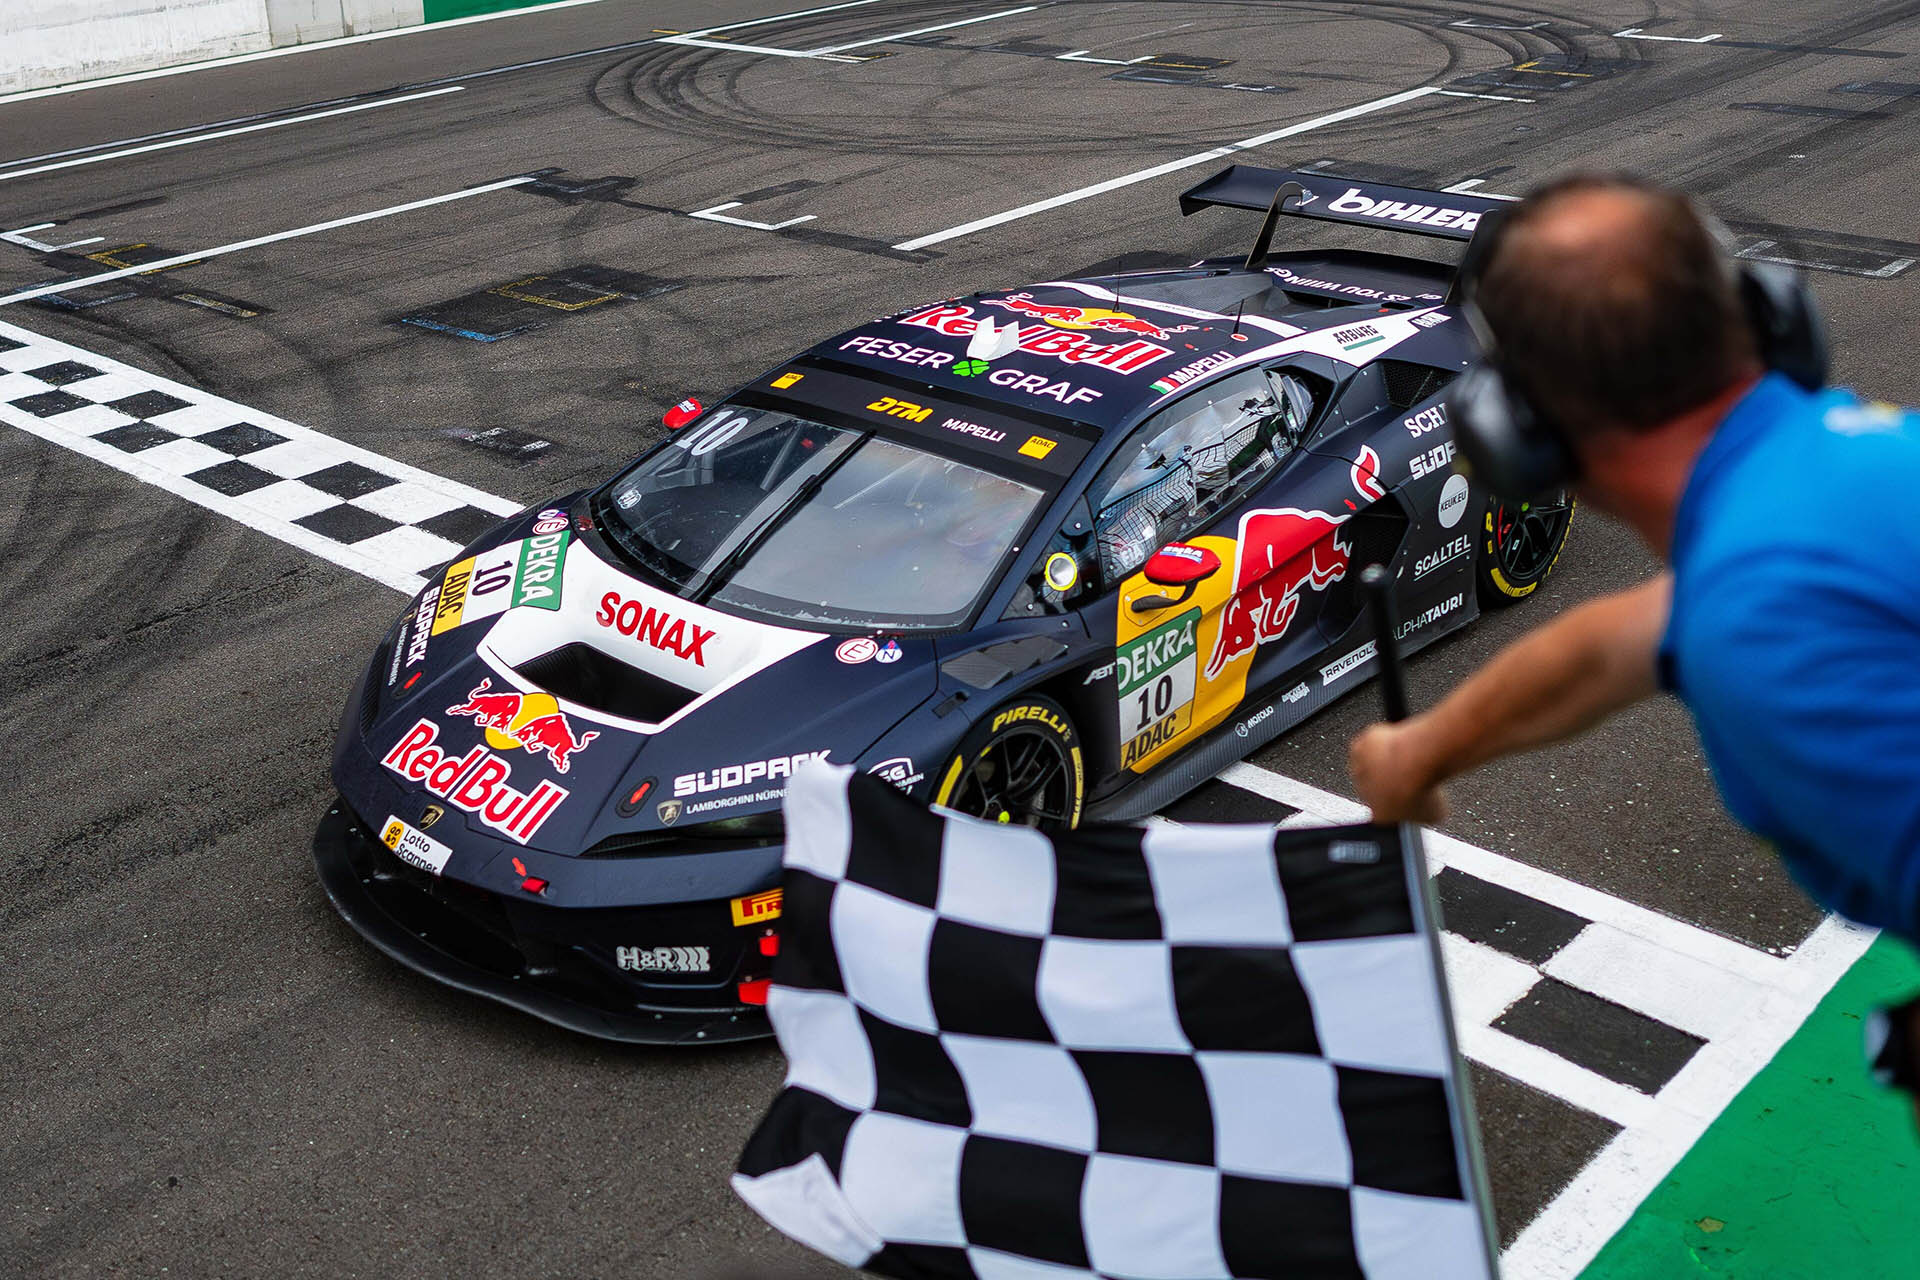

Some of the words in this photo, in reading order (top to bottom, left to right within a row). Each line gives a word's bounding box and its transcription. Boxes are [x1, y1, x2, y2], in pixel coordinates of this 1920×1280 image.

[1342, 285, 1385, 299] YOU
[1020, 327, 1174, 376] Bull
[1171, 351, 1236, 385] MAPELLI
[839, 336, 954, 369] FESER
[988, 368, 1103, 405] GRAF
[866, 397, 933, 423] DTM
[675, 410, 748, 456] 10
[942, 418, 1007, 442] MAPELLI
[1031, 436, 1055, 449] ADAC
[1409, 440, 1457, 480] SÜDP
[519, 533, 562, 604] DEKRA
[1414, 534, 1472, 577] SCALTEL
[437, 571, 471, 619] ADAC
[471, 560, 513, 596] 10
[405, 585, 441, 668] SÜDPACK
[596, 591, 717, 667] SONAX
[1083, 662, 1116, 685] ABT
[1117, 620, 1194, 691] DEKRA
[1326, 644, 1374, 679] RAVENOL
[991, 706, 1067, 734] PIRELLI
[1136, 674, 1173, 731] 10
[1124, 712, 1177, 768] ADAC
[380, 718, 490, 798] Red
[448, 754, 570, 845] Bull
[687, 793, 754, 815] LAMBORGHINI
[396, 843, 438, 874] Scanner
[403, 829, 431, 853] Lotto
[741, 889, 784, 917] PIR
[616, 946, 678, 972] H&R
